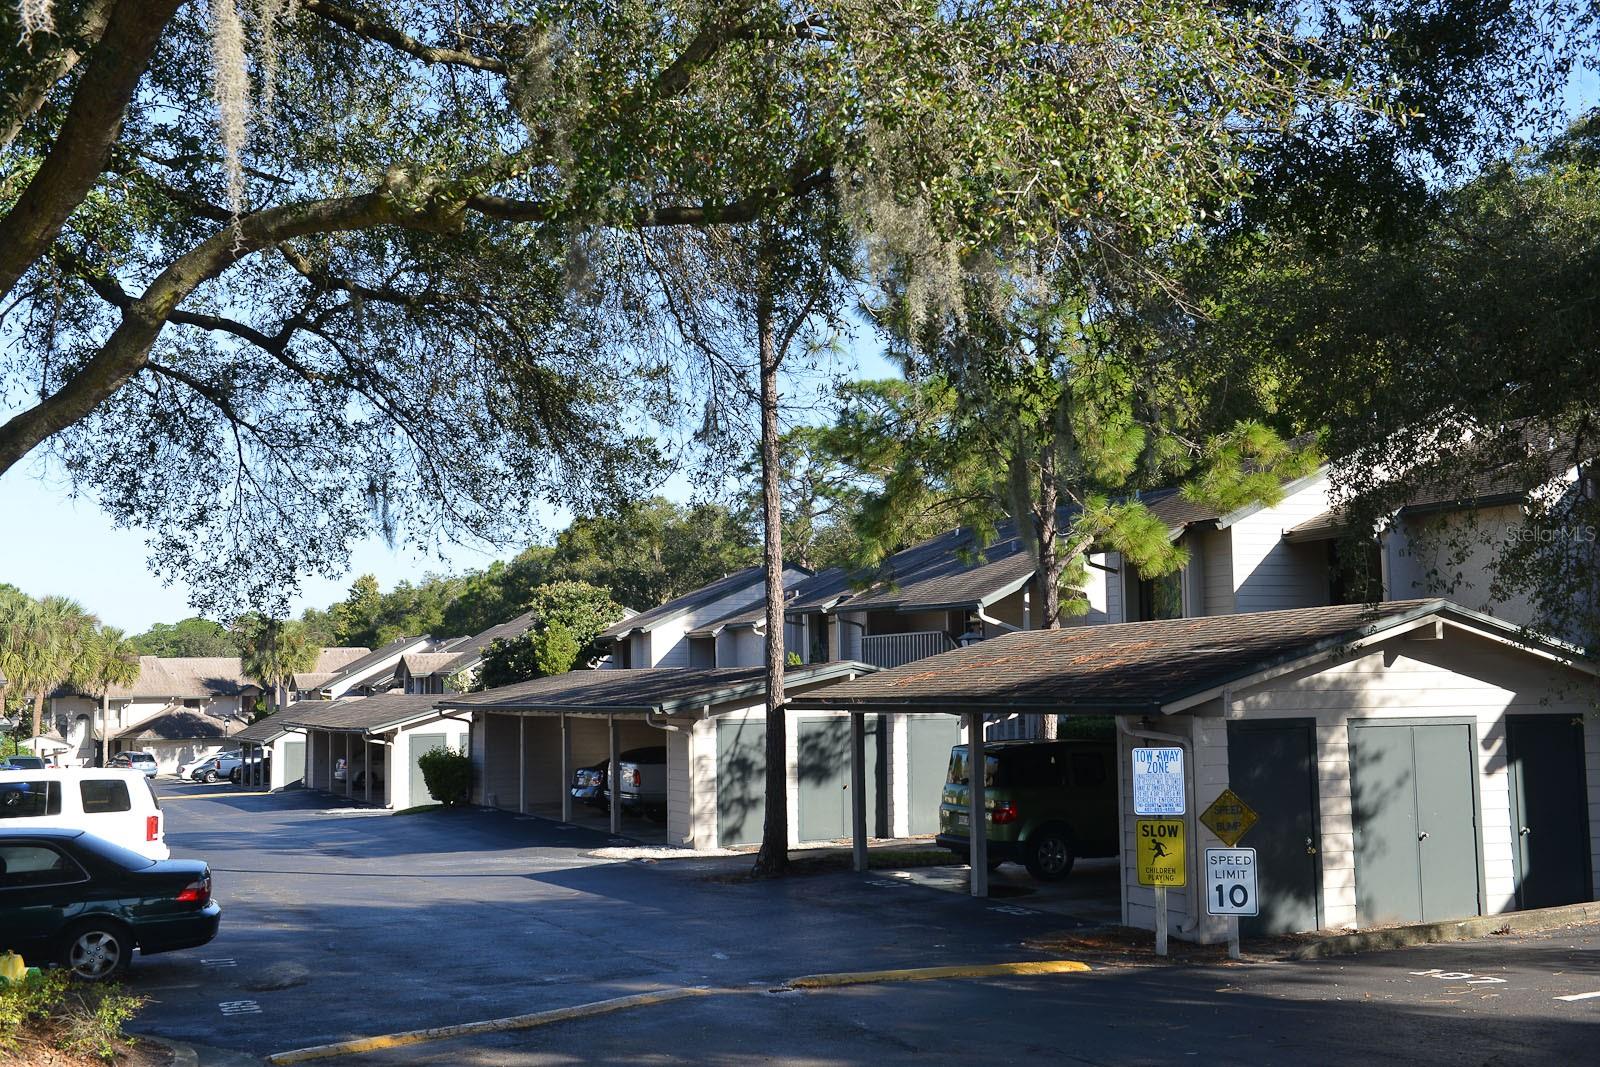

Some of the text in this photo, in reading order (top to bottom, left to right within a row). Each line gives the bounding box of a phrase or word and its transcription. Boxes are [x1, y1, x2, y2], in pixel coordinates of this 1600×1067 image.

[1135, 750, 1180, 762] TOW AWAY
[1147, 762, 1170, 773] ZONE
[1214, 805, 1242, 816] SPEED
[1142, 824, 1179, 838] SLOW
[1216, 821, 1241, 832] BUMP
[1210, 855, 1252, 866] SPEED
[1145, 867, 1176, 875] CHILDREN
[1215, 869, 1248, 880] LIMIT
[1147, 874, 1175, 882] PLAYING
[1215, 883, 1249, 908] 10
